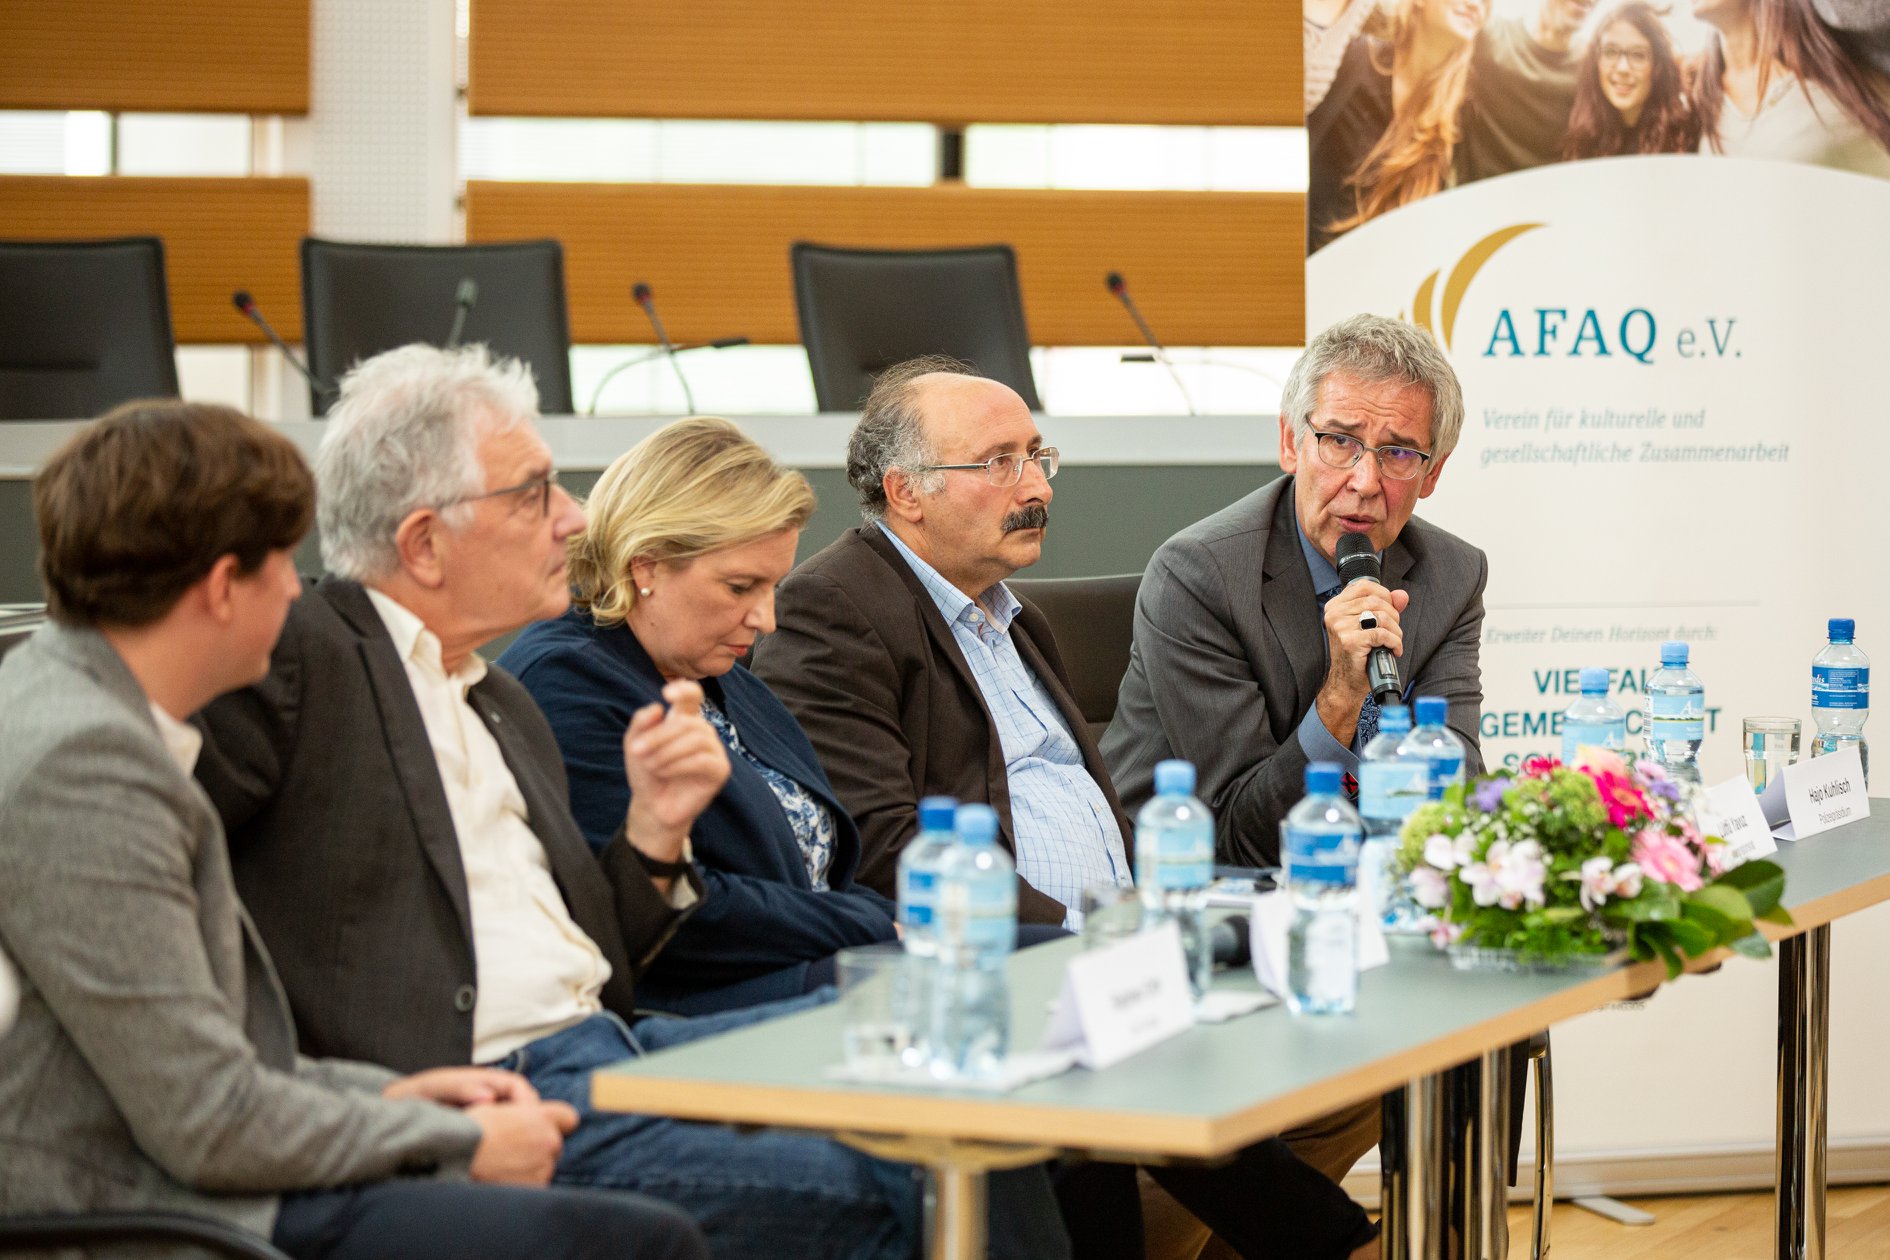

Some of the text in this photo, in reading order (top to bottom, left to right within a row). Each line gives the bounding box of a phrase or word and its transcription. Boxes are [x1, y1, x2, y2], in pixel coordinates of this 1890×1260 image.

[1482, 307, 1743, 365] AFAQ e.V.
[1483, 406, 1706, 434] Verein für kulturelle und
[1480, 439, 1790, 469] gesellschaftliche Zusammenarbeit
[1486, 626, 1547, 644] Erweiter
[1551, 625, 1604, 643] Deinen
[1608, 624, 1670, 642] Horizont
[1534, 667, 1664, 695] VIEFAL
